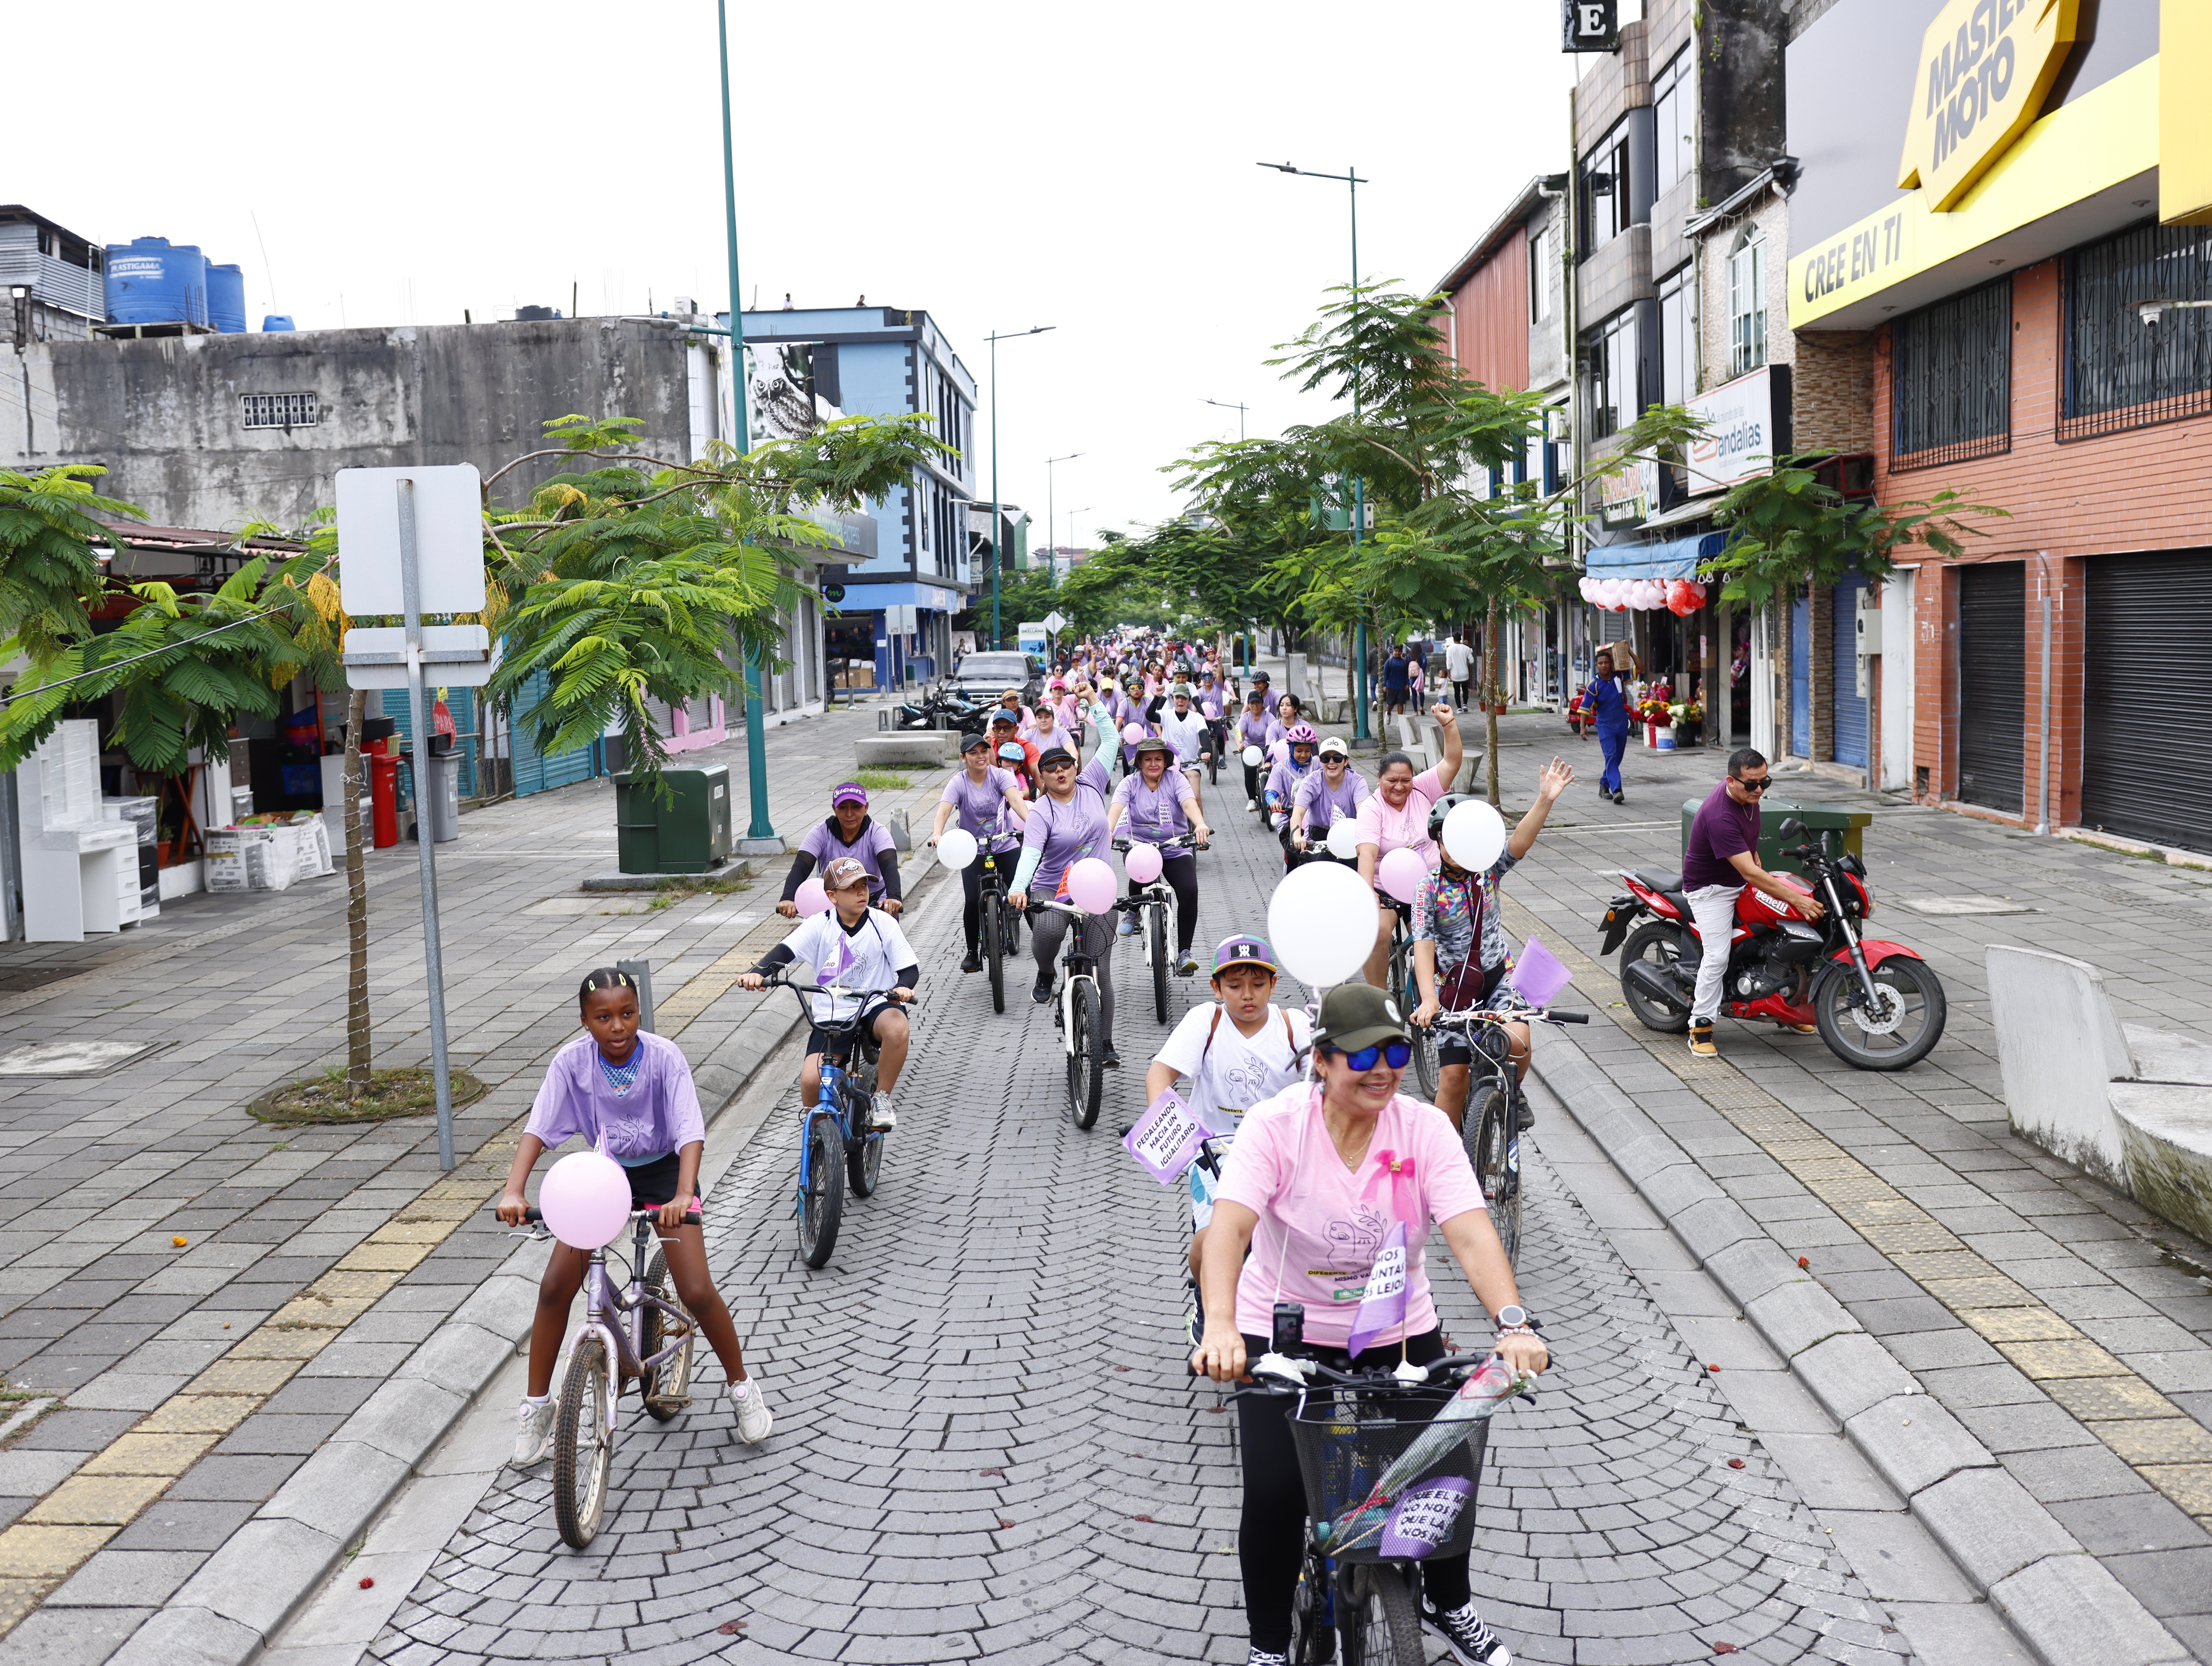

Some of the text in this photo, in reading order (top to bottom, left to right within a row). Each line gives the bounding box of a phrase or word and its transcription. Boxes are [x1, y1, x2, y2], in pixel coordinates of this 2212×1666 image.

[1578, 4, 1606, 36] E
[1933, 36, 2014, 172] MOTO
[111, 262, 160, 273] PLASTIGAMA
[1806, 213, 1902, 303] CREE EN TI
[931, 588, 946, 607] JAHER
[834, 788, 865, 798] Queen
[1416, 888, 1426, 907] BIKE
[1755, 890, 1789, 913] Benelli
[1136, 1101, 1175, 1149] PEDALEANDO
[1149, 1113, 1177, 1149] HACIA UN
[1160, 1123, 1181, 1153] FUTURO
[1160, 1123, 1195, 1167] IGUALITARIO
[1377, 1277, 1404, 1295] LEJOS.
[1425, 1503, 1450, 1514] NOS
